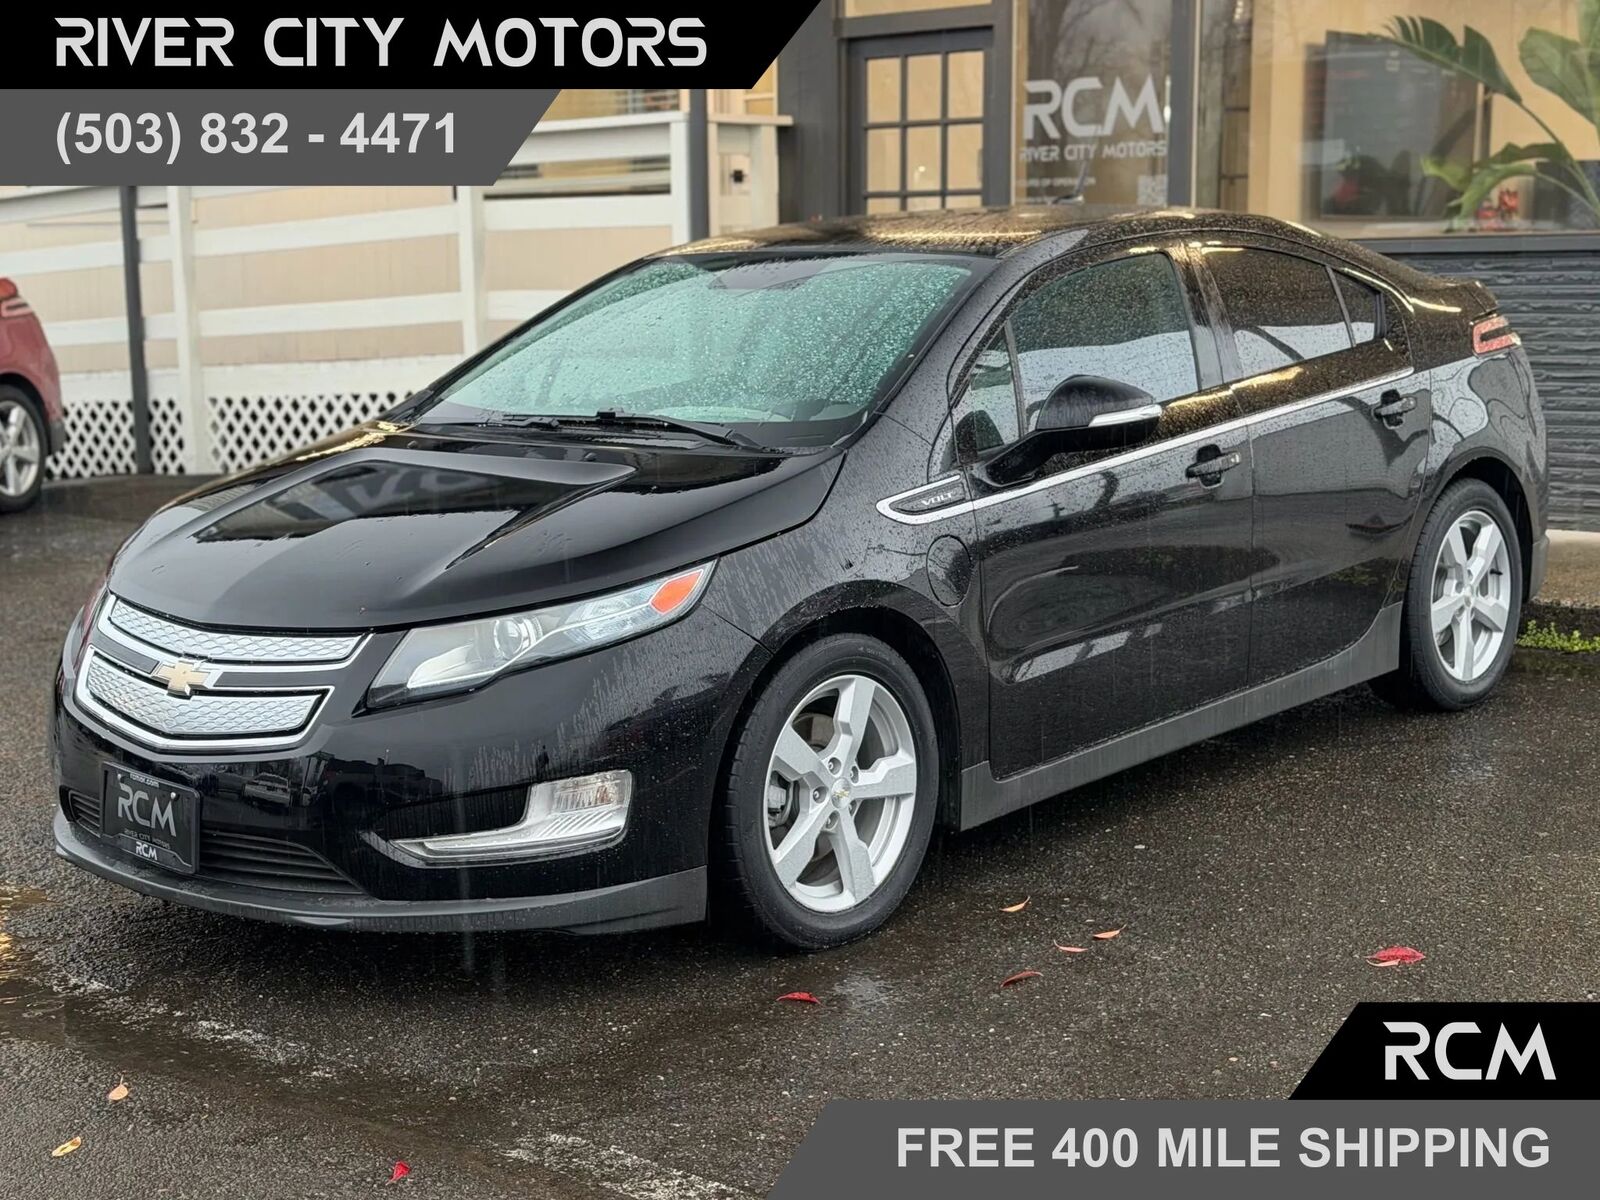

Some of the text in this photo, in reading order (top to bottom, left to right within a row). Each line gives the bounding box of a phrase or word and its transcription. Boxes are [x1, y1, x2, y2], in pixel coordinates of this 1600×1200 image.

[1024, 76, 1165, 139] RCM
[1020, 141, 1167, 161] RIVER CITY MOTORS
[922, 493, 953, 505] VOLT
[118, 784, 177, 837] RCM
[136, 841, 158, 860] RCM
